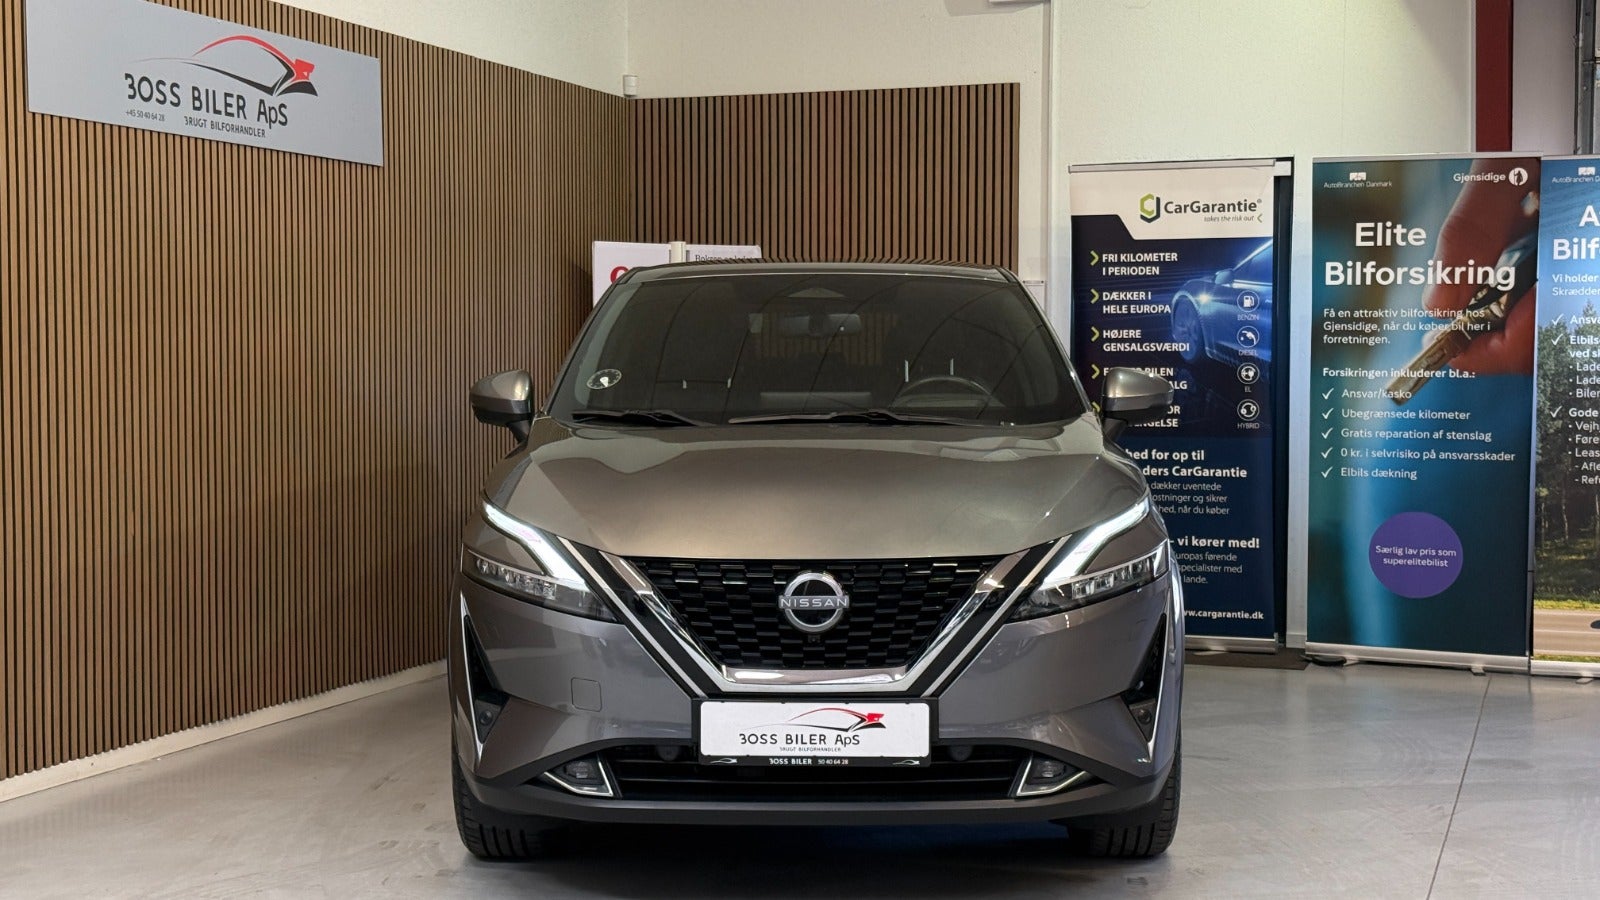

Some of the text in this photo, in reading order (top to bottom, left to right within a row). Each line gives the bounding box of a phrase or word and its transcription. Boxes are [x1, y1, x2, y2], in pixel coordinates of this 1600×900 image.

[192, 85, 247, 120] BILER
[257, 99, 288, 129] ApS
[210, 121, 266, 138] BILFORHANDLER
[1453, 173, 1506, 184] Gjensidige
[1324, 181, 1364, 189] AutoBranchen
[1221, 214, 1231, 222] the
[1232, 214, 1243, 222] risk
[1579, 205, 1600, 227] A
[1355, 221, 1427, 247] Elite
[1553, 237, 1600, 260] Bilf
[1102, 253, 1178, 263] FRI KILOMETER
[1108, 266, 1160, 276] PERIODEN
[1325, 259, 1516, 291] Bilforsikring
[1552, 274, 1599, 283] Vi holder
[1103, 292, 1146, 301] DÆKKER
[1103, 305, 1171, 314] HELE EUROPA
[1323, 308, 1485, 319] Få en attraktiv bilforsikring hos
[1323, 321, 1380, 332] Gjensidige,
[1383, 321, 1400, 331] når
[1402, 321, 1416, 331] du
[1418, 321, 1449, 331] køber
[1451, 321, 1464, 331] bil
[1467, 321, 1484, 331] her
[1103, 329, 1141, 339] HØJERE
[1323, 334, 1391, 346] forretningen.
[1103, 342, 1190, 352] GENSALGSVÆRDI
[1569, 349, 1590, 358] ved
[1576, 362, 1600, 371] Lade
[1322, 367, 1476, 380] Forsikringen inkluderer bl.a.:
[1576, 375, 1600, 385] Lade
[1341, 388, 1412, 399] Ansvar/kasko
[1341, 409, 1470, 420] Ubegrænsede kilometer
[1569, 408, 1599, 417] Gode
[1575, 421, 1600, 433] Vejh
[1341, 428, 1492, 442] Gratis reparation af stenslag
[1575, 434, 1600, 444] Føre
[1151, 449, 1169, 460] for
[1172, 452, 1189, 463] op
[1191, 450, 1205, 461] til
[1341, 448, 1348, 458] 0
[1350, 448, 1363, 458] kr.
[1370, 448, 1420, 459] selvrisiko
[1422, 449, 1436, 461] på
[1438, 450, 1515, 462] ansvarsskader
[1575, 448, 1600, 458] Leas
[1142, 465, 1248, 478] ders CarGarantie
[1341, 467, 1417, 480] Elbils dækning
[1151, 481, 1222, 491] dækker uventede
[1152, 494, 1228, 504] ostninger og sikrer
[1178, 505, 1191, 514] når
[1193, 505, 1204, 514] du
[1206, 505, 1230, 515] køber
[1177, 536, 1188, 546] vi
[1192, 536, 1225, 547] kører
[1228, 538, 1260, 549] med!
[1375, 545, 1456, 558] Særlig lav pris som
[1175, 552, 1237, 563] uropas førende
[1383, 556, 1448, 567] superelitebilist
[1179, 563, 1242, 573] specialister med
[1183, 575, 1208, 584] lande.
[780, 598, 847, 607] NISSAN
[785, 734, 826, 745] BILER
[834, 734, 860, 748] ApS
